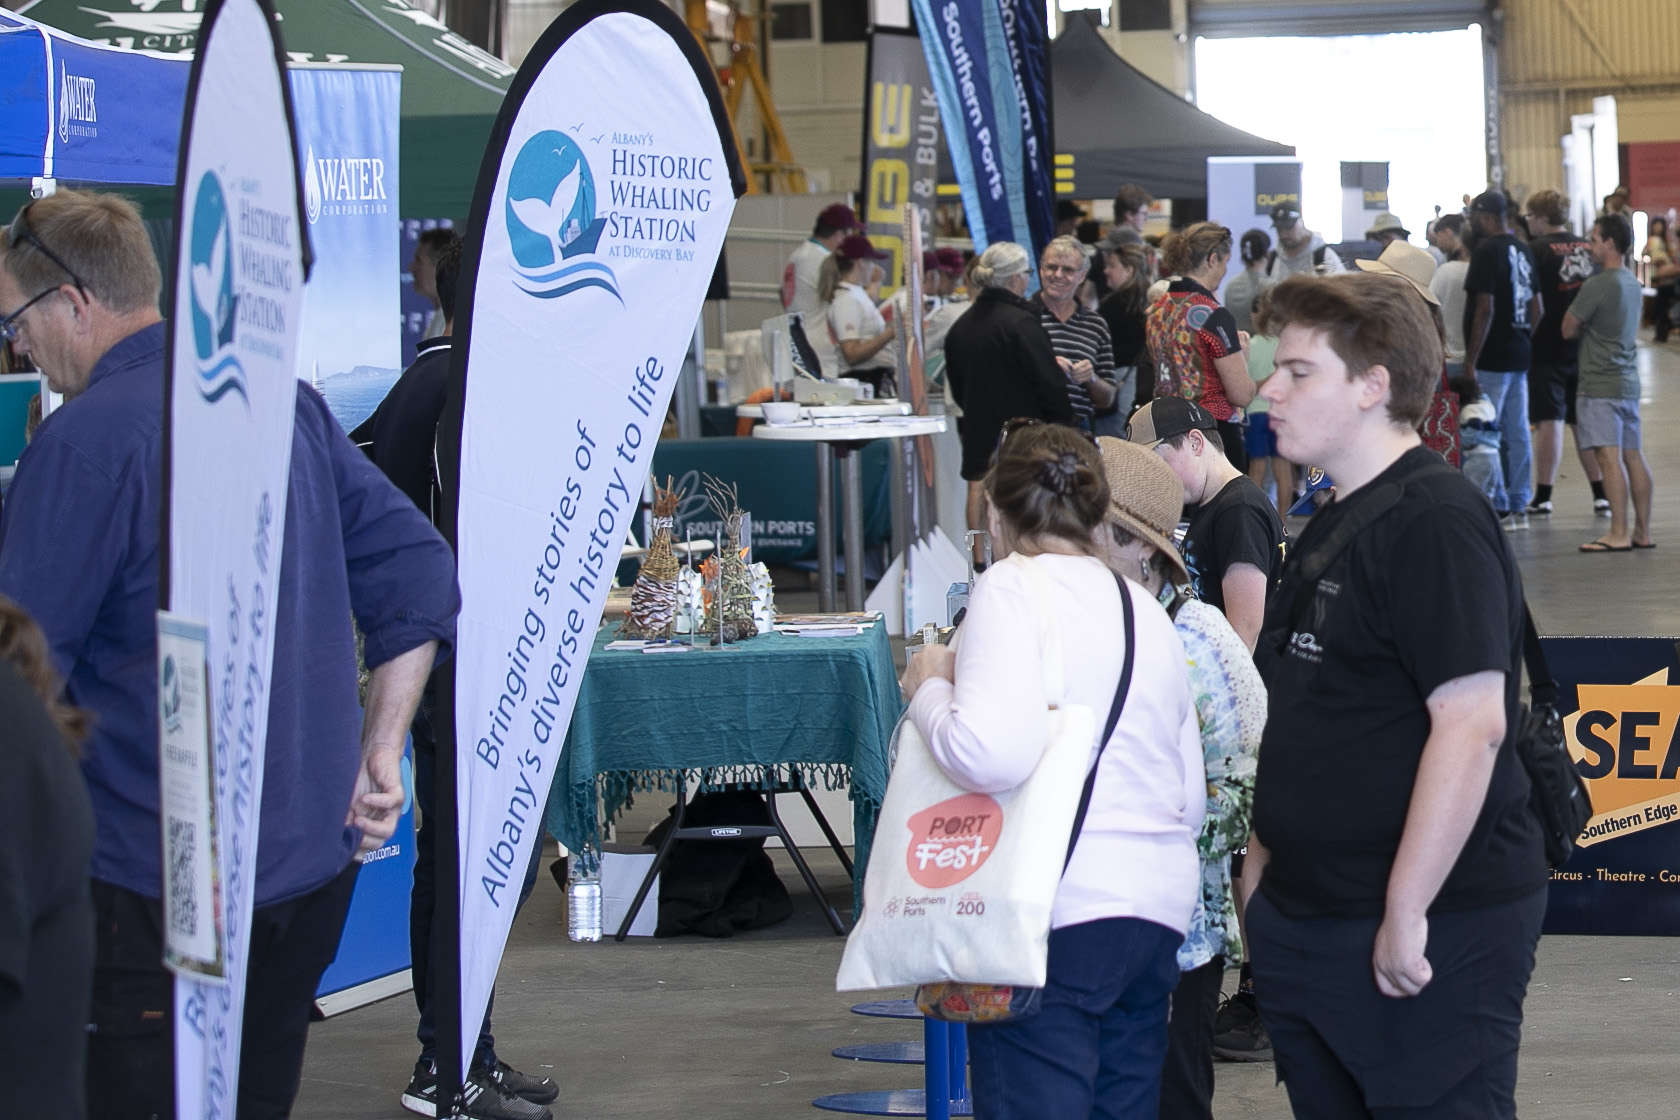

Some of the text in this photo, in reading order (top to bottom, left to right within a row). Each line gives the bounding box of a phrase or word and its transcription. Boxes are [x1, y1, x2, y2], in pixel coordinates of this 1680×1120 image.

[67, 74, 97, 122] WATER
[942, 1, 1003, 201] Southern Ports
[318, 158, 387, 201] WATER
[612, 149, 712, 181] HISTORIC
[323, 204, 387, 216] CORPORATION
[610, 180, 711, 212] WHALING
[609, 211, 696, 242] STATION
[768, 521, 815, 536] PORTS
[476, 419, 596, 770] Bringing stories of
[481, 356, 664, 908] Albany's diverse history to life
[929, 814, 991, 835] PORT
[1581, 814, 1642, 840] Southern
[1643, 802, 1678, 823] Edge
[915, 836, 990, 870] Fest
[1596, 868, 1646, 882] Theatre
[903, 906, 927, 917] Ports
[905, 896, 946, 906] Southern
[956, 900, 986, 916] 200
